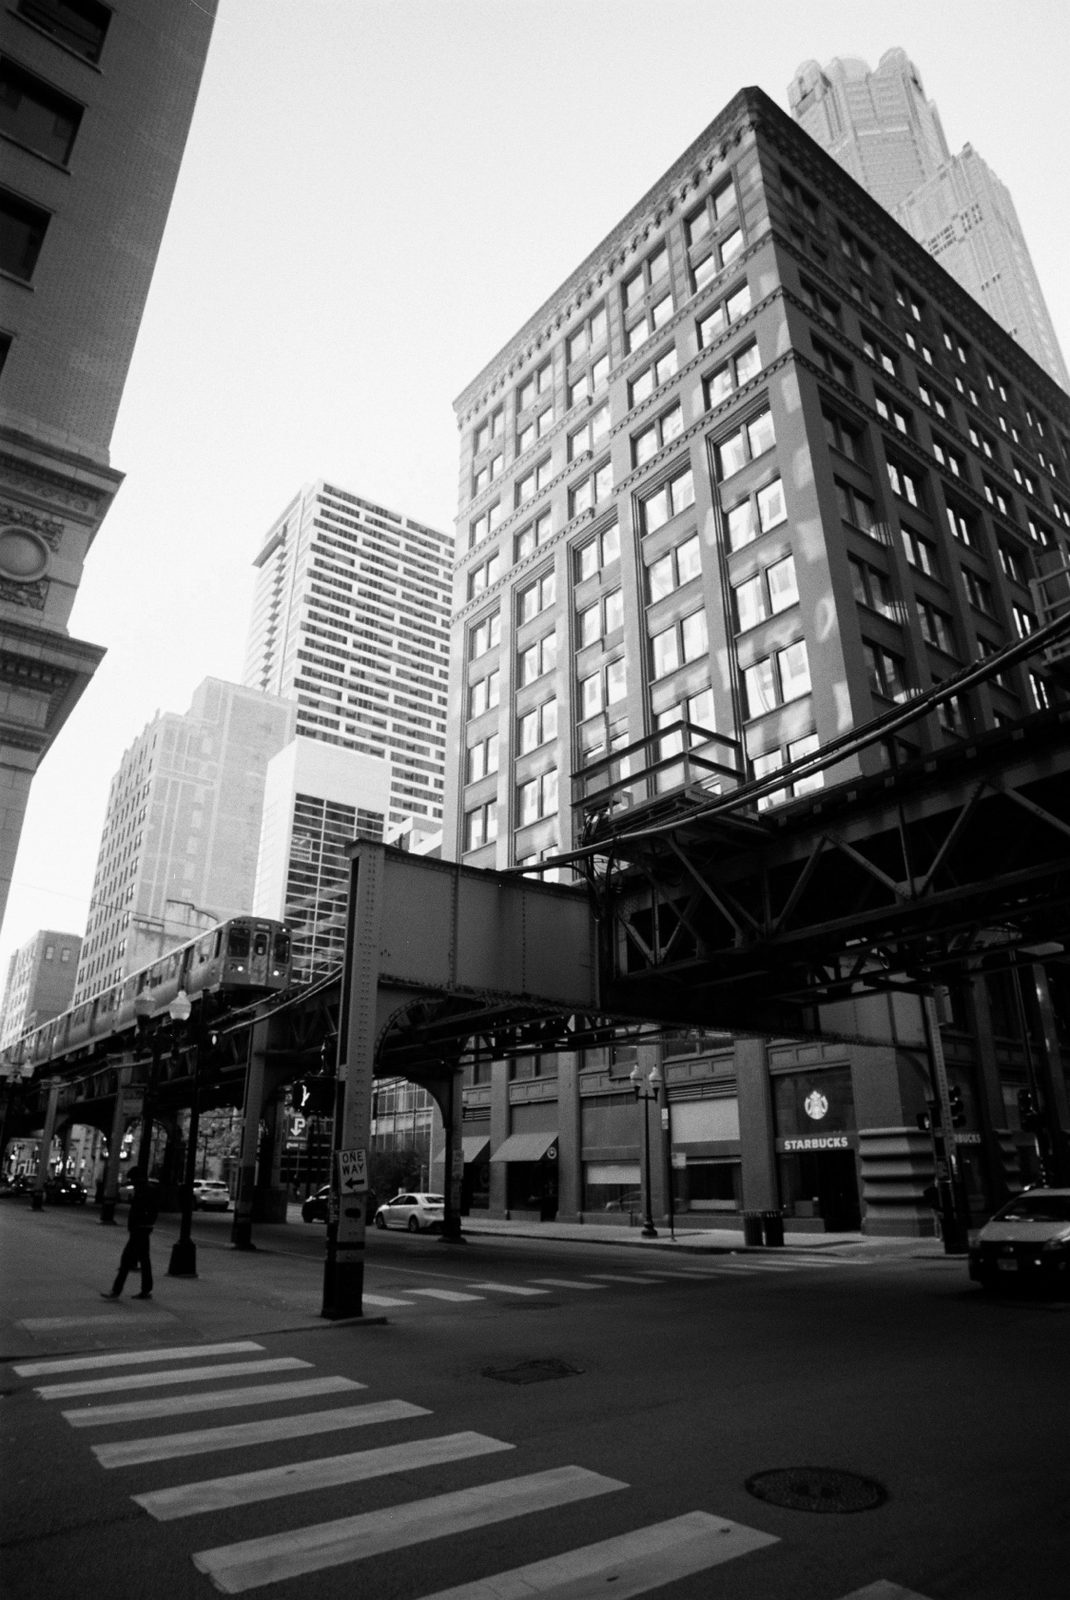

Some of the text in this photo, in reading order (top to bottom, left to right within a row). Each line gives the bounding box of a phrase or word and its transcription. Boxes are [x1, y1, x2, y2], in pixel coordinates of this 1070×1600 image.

[784, 1137, 849, 1150] STARBUCKS
[342, 1151, 363, 1163] ONE
[342, 1163, 364, 1175] WAY
